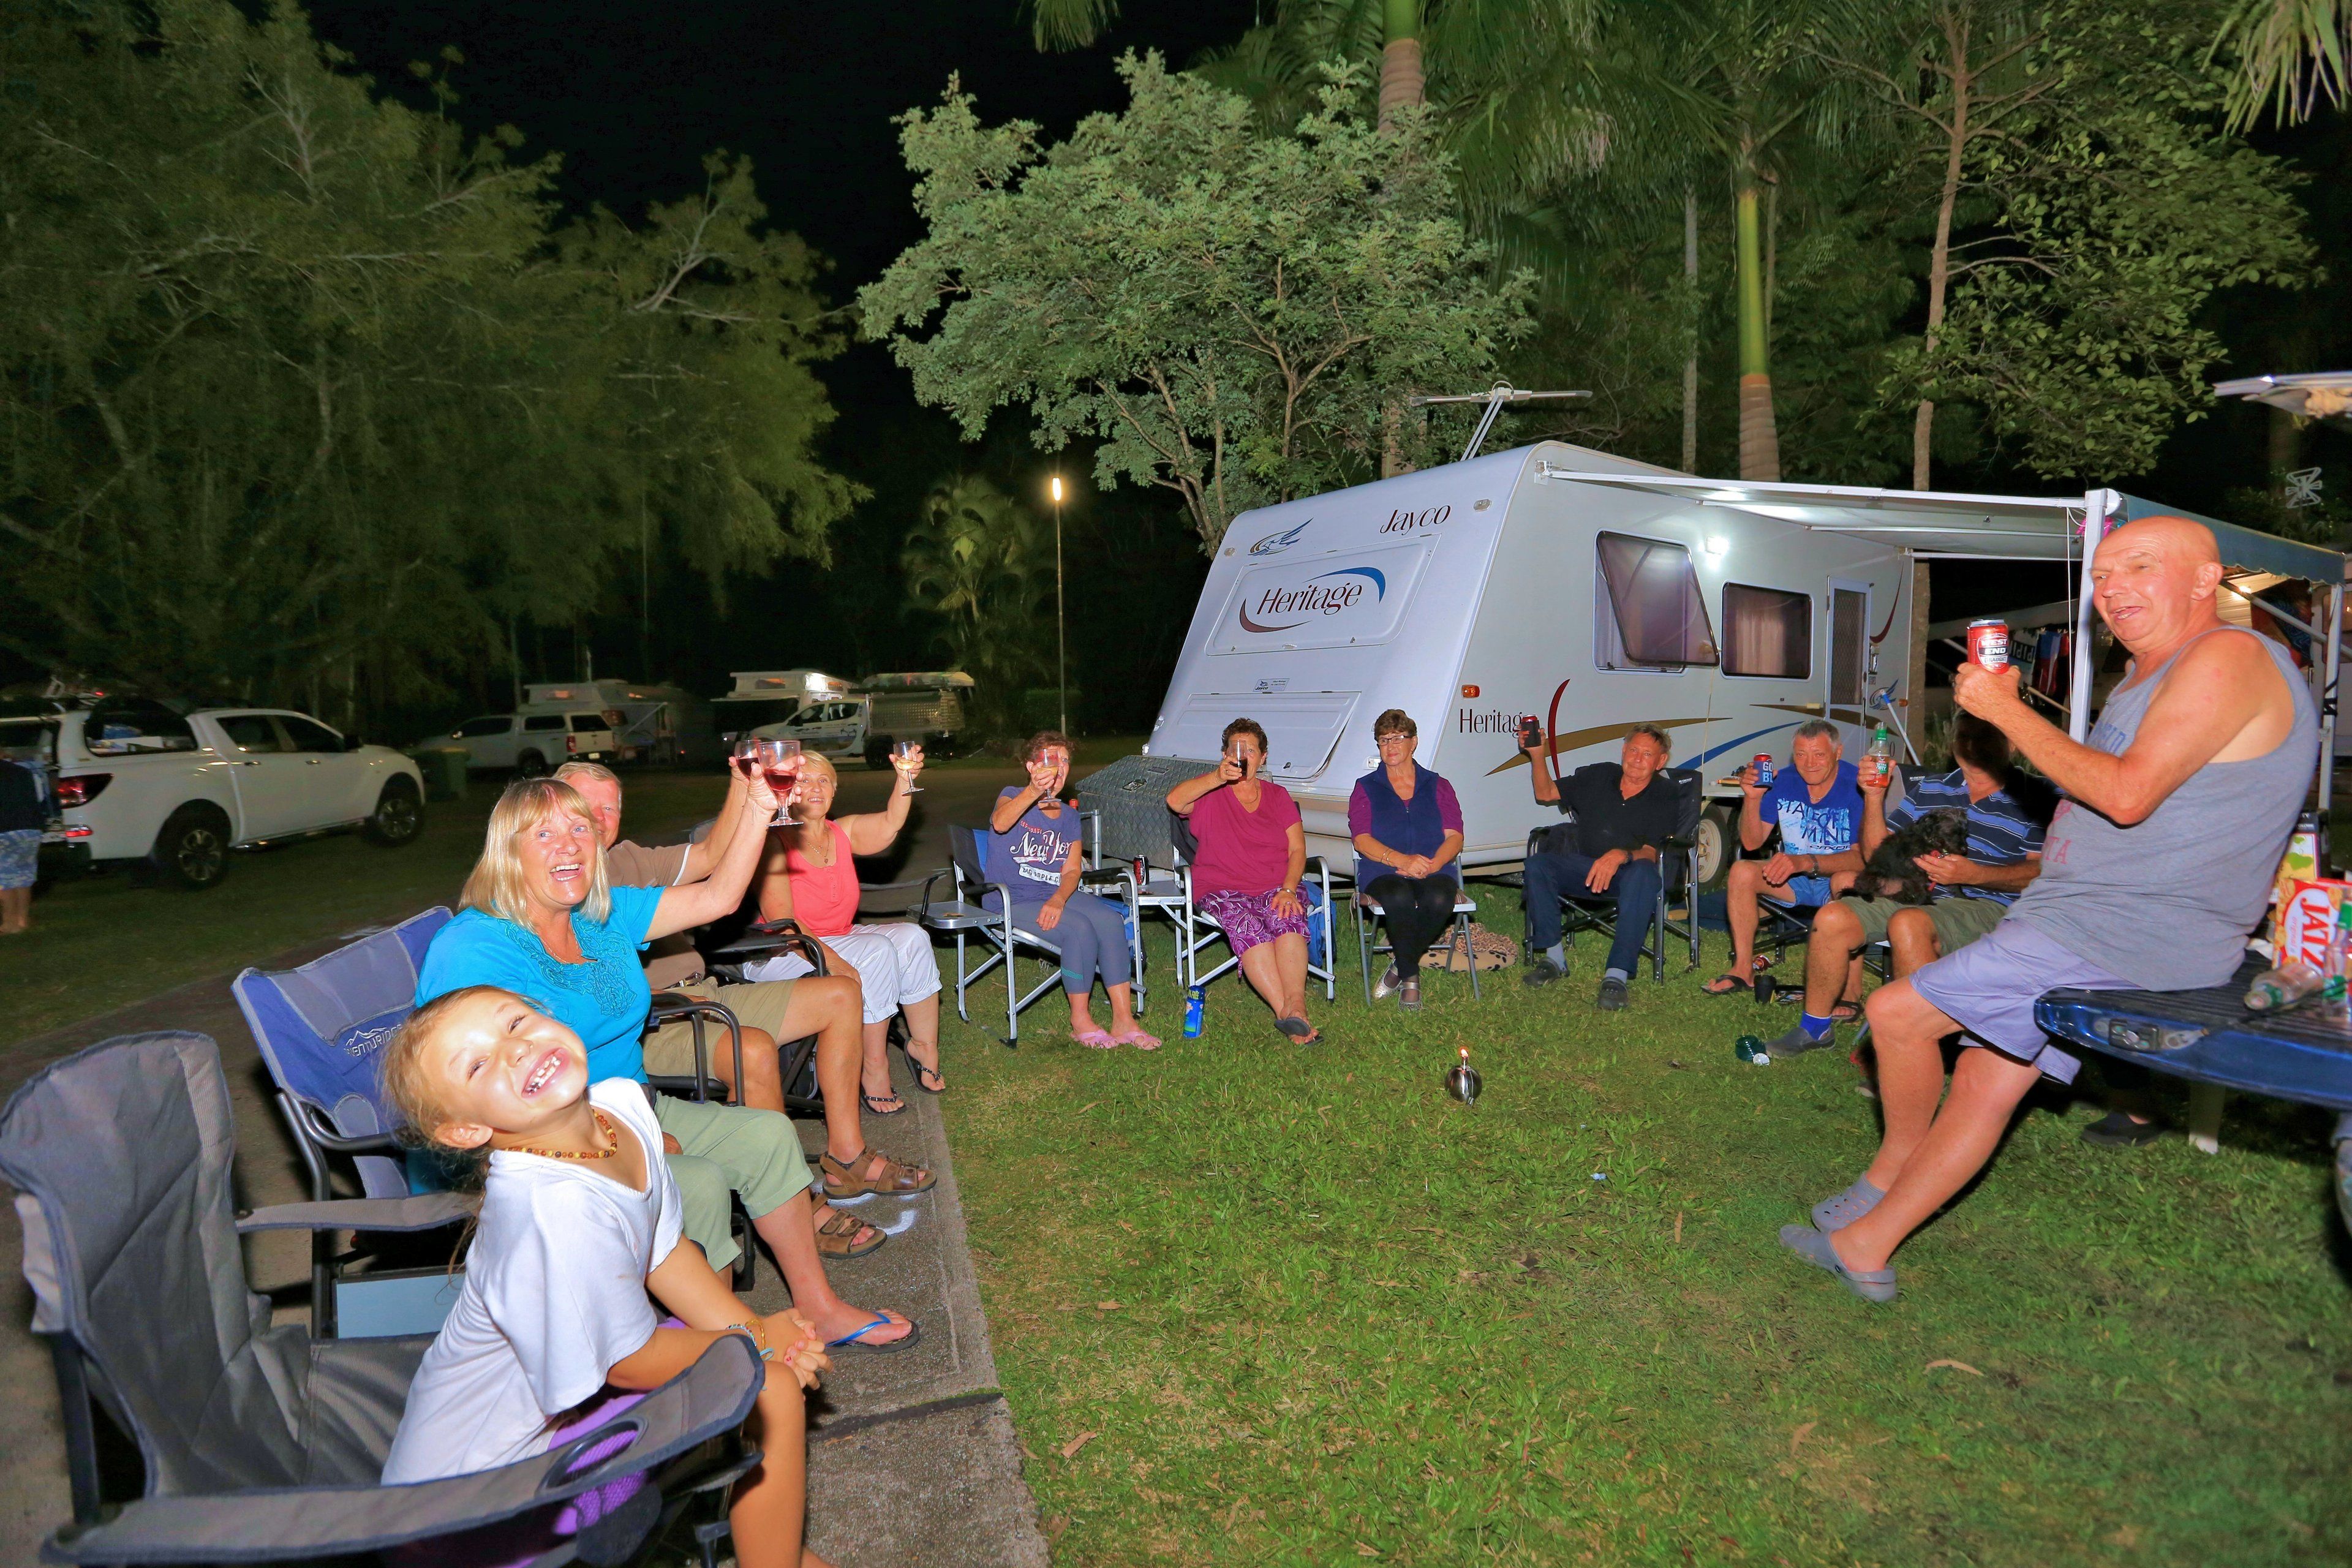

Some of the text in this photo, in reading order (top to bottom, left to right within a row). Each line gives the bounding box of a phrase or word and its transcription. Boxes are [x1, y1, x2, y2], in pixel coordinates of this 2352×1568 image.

[1379, 505, 1452, 535] Jayco
[1256, 582, 1363, 616] Heritage
[1460, 708, 1523, 739] Heritag
[1763, 761, 1773, 772] GO
[1009, 830, 1072, 865] New Yor
[2301, 897, 2330, 968] JATZ
